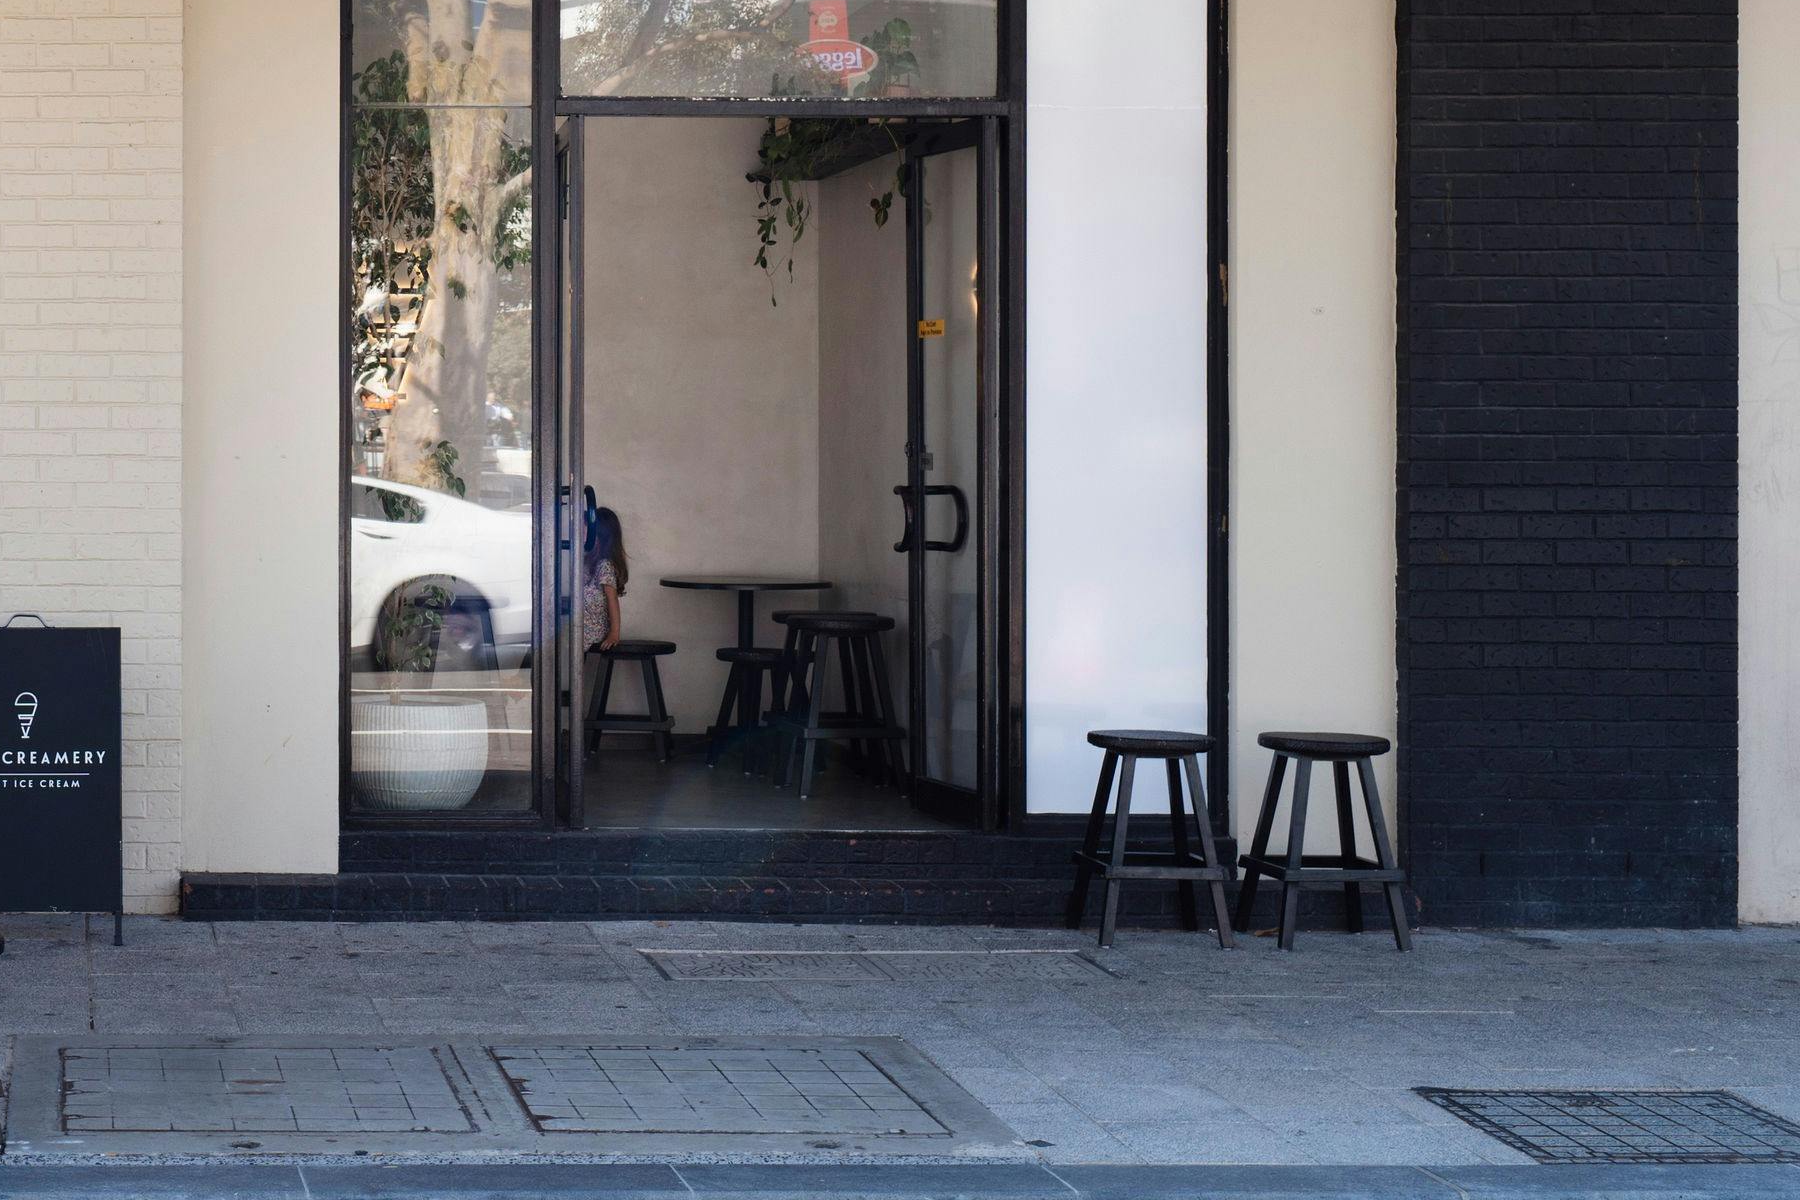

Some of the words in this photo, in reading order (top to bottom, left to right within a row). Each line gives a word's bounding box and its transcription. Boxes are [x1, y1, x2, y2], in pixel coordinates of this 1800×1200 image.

[1, 750, 106, 765] CREAMERY
[14, 779, 34, 788] ICE
[39, 779, 80, 788] CREAM
